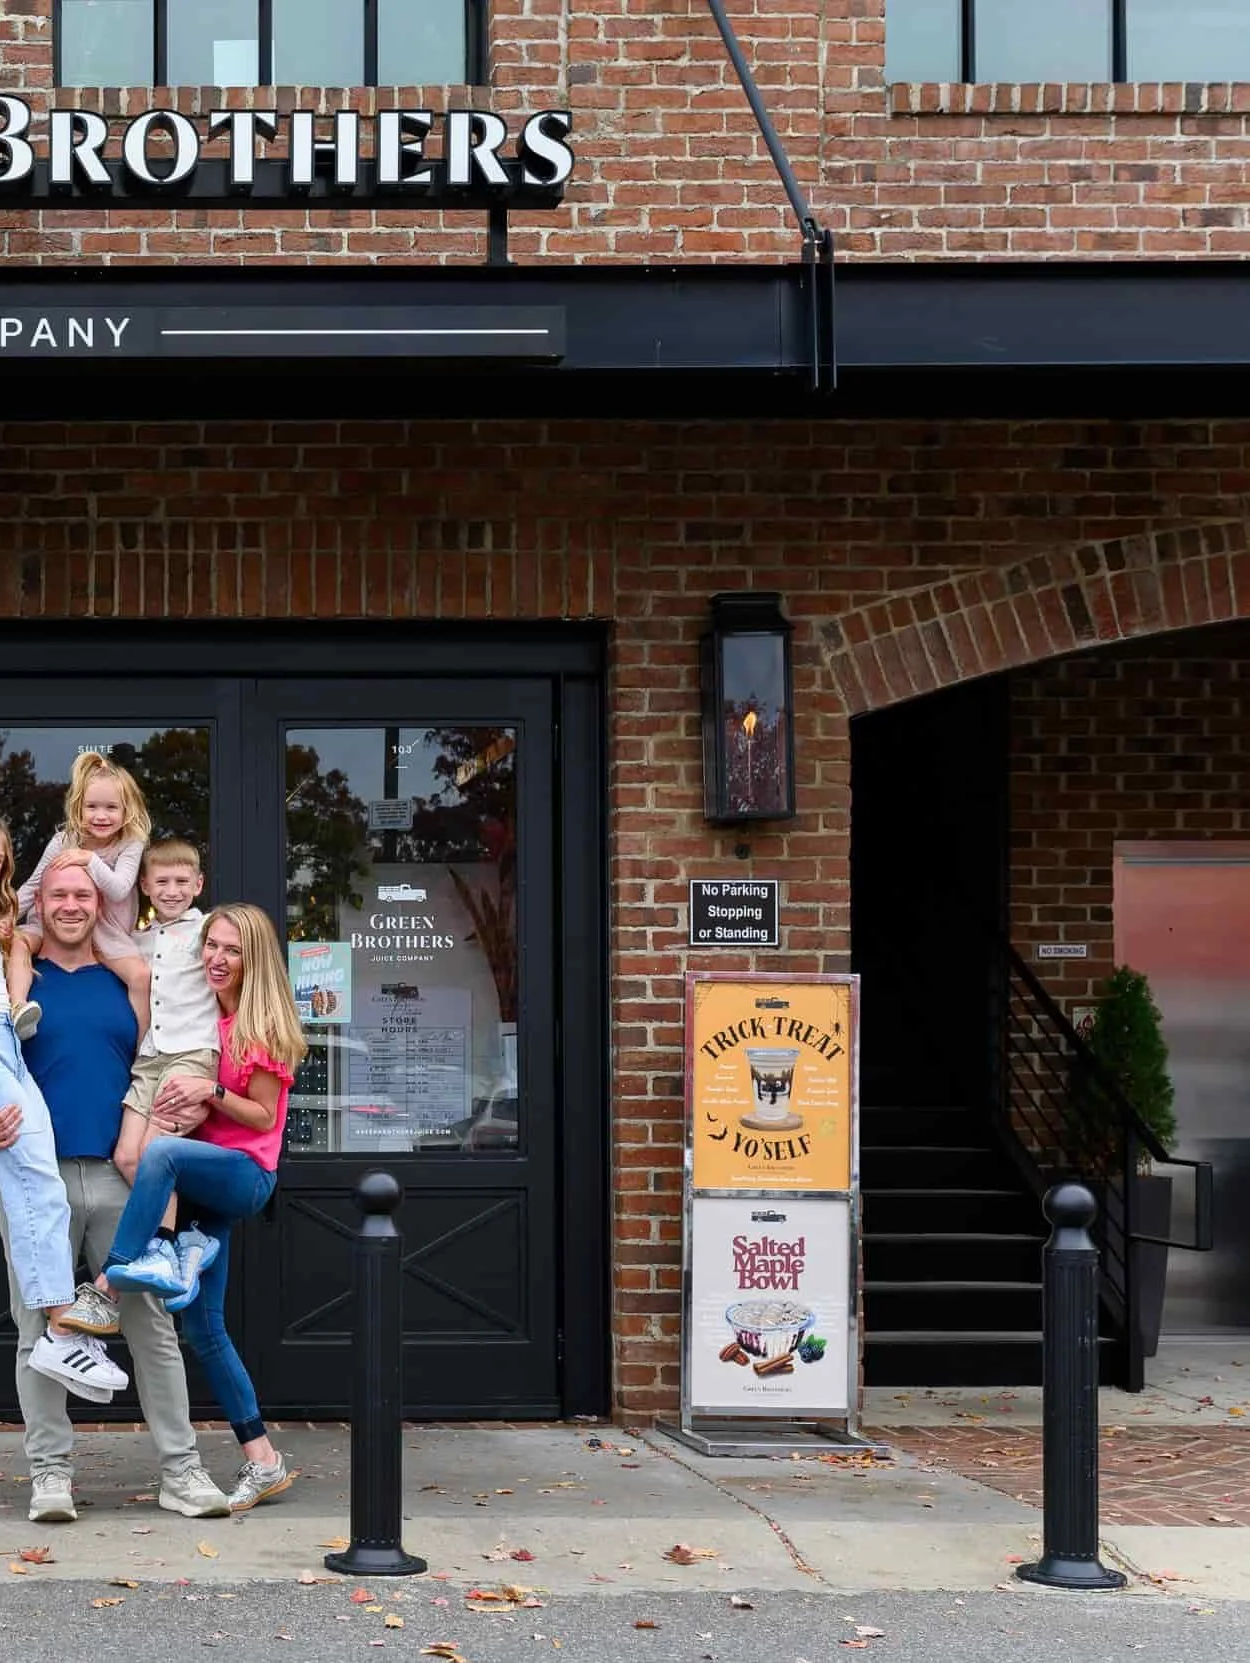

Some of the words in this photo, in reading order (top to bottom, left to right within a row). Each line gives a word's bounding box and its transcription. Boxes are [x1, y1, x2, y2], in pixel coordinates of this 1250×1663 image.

[77, 744, 114, 753] SUITE
[391, 744, 412, 754] 103
[702, 884, 719, 896] No
[722, 884, 768, 898] Parking
[708, 905, 762, 920] Stopping
[370, 914, 436, 930] GREEN
[351, 933, 454, 949] BROTHERS
[699, 929, 712, 938] or
[715, 926, 768, 941] Standing
[302, 954, 334, 972] NOW
[382, 1016, 417, 1025] STORE
[700, 1016, 766, 1060] TRICK
[773, 1016, 845, 1061] TREAT
[732, 1132, 811, 1160] YO'SELF
[733, 1235, 806, 1256] Salted
[733, 1253, 804, 1273] Maple
[737, 1271, 799, 1290] Bowl
